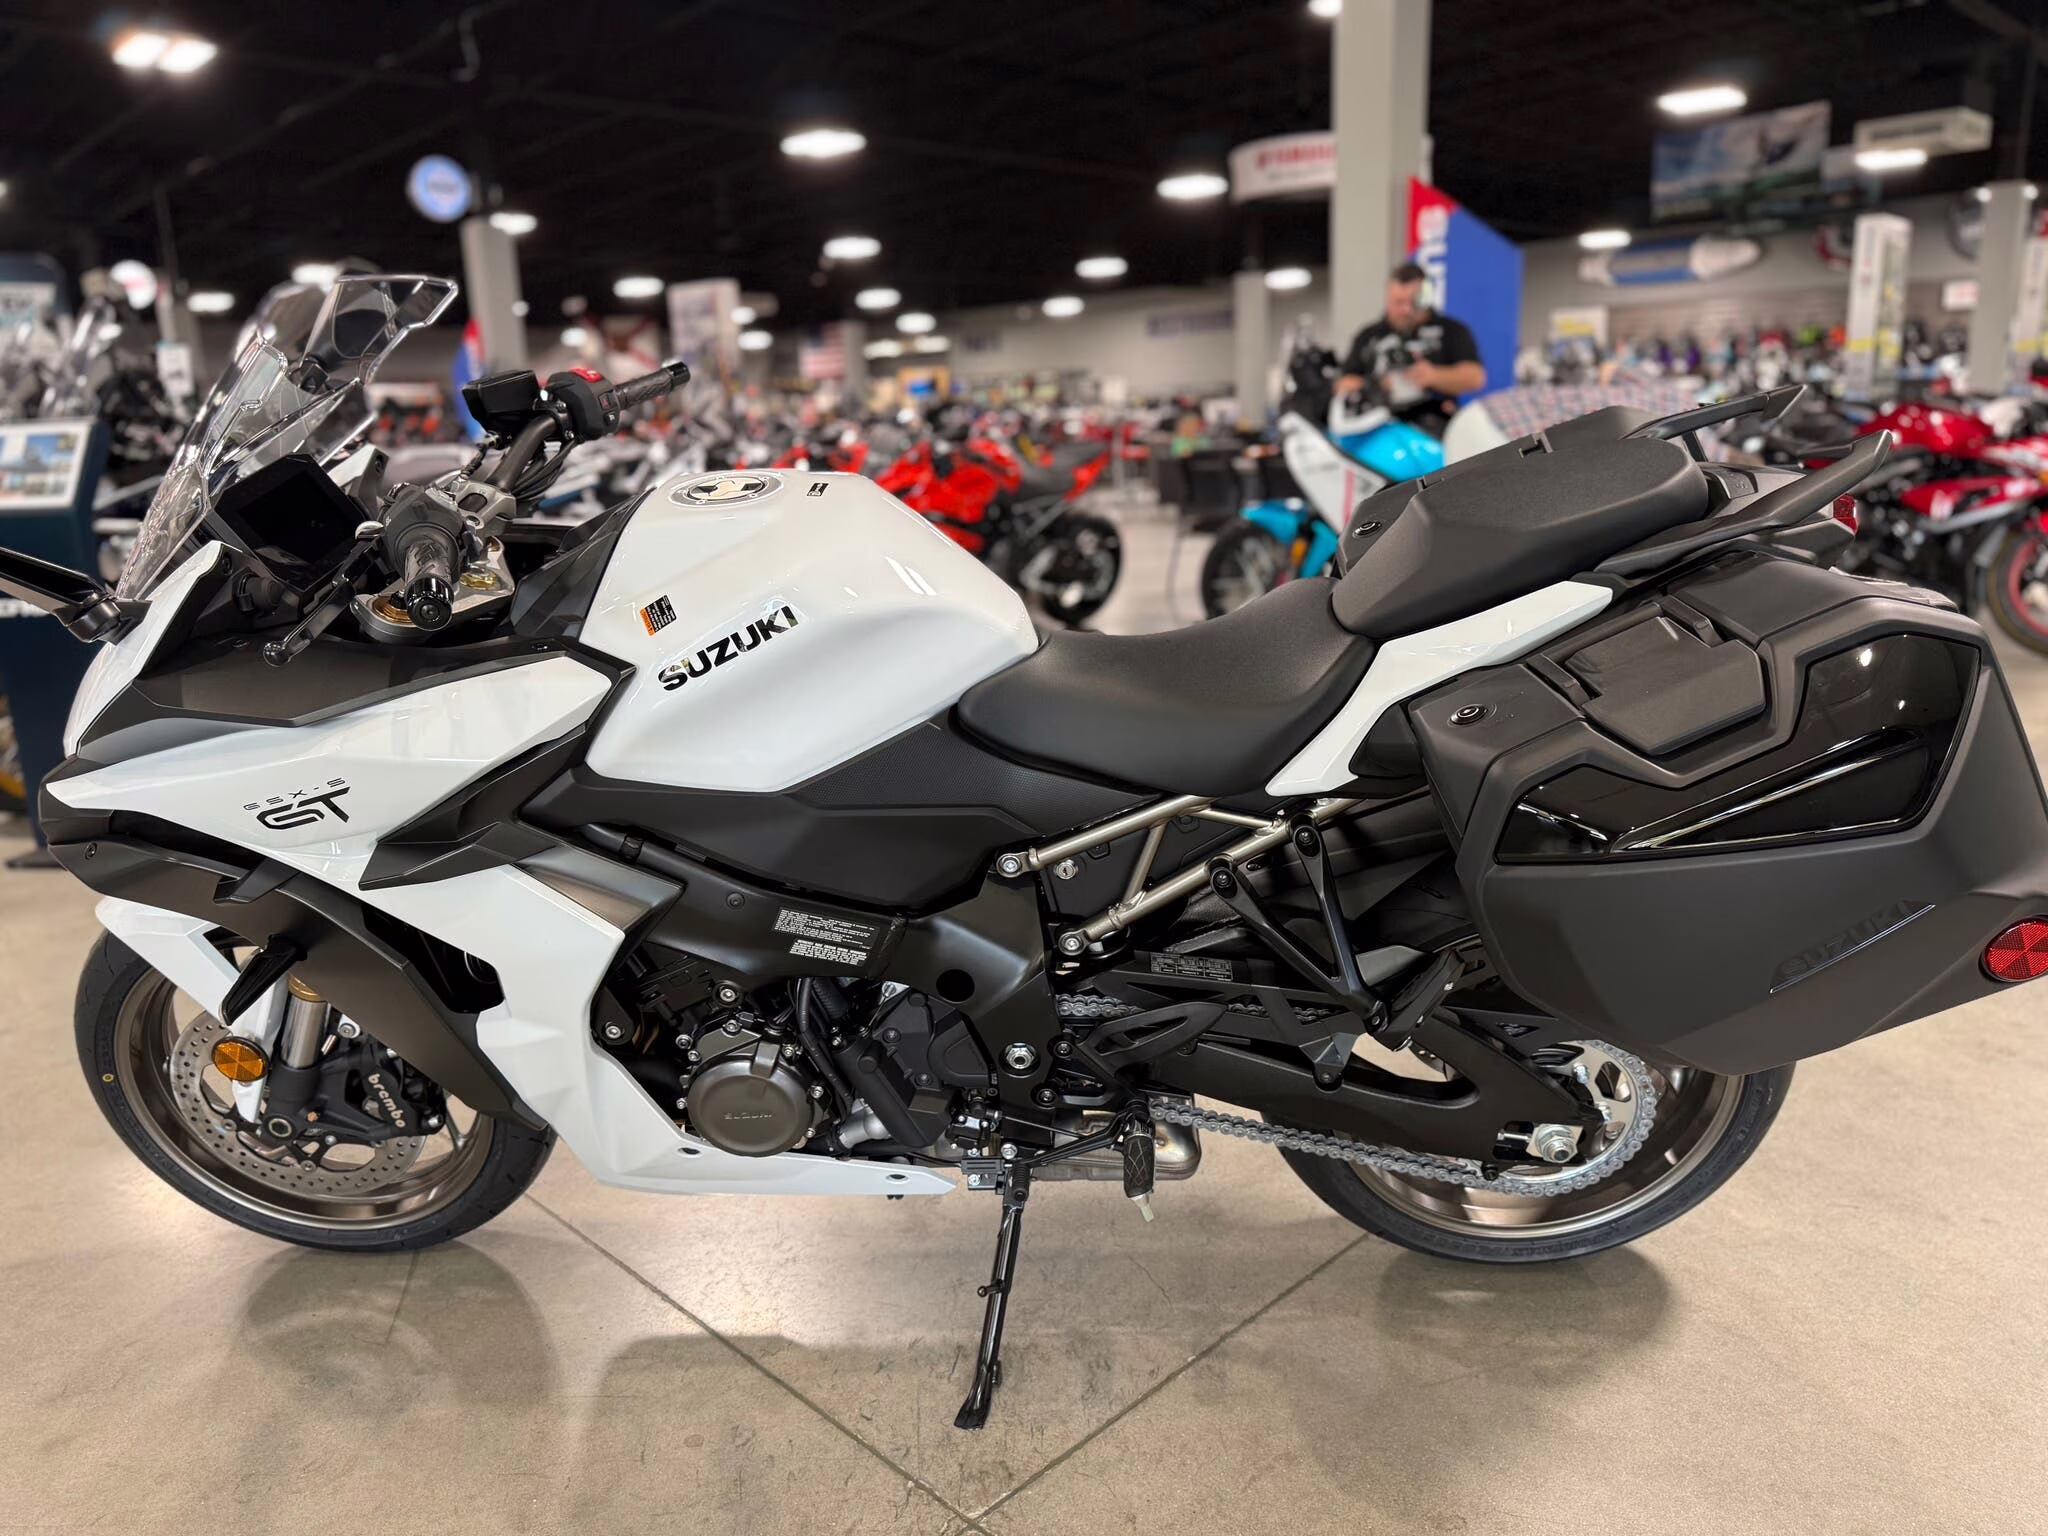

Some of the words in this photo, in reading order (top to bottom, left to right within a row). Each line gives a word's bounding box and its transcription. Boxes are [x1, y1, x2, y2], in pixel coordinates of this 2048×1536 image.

[658, 606, 799, 691] SUZUKI
[243, 777, 346, 811] GSX-S
[256, 786, 351, 830] GT
[368, 1073, 406, 1128] brembo
